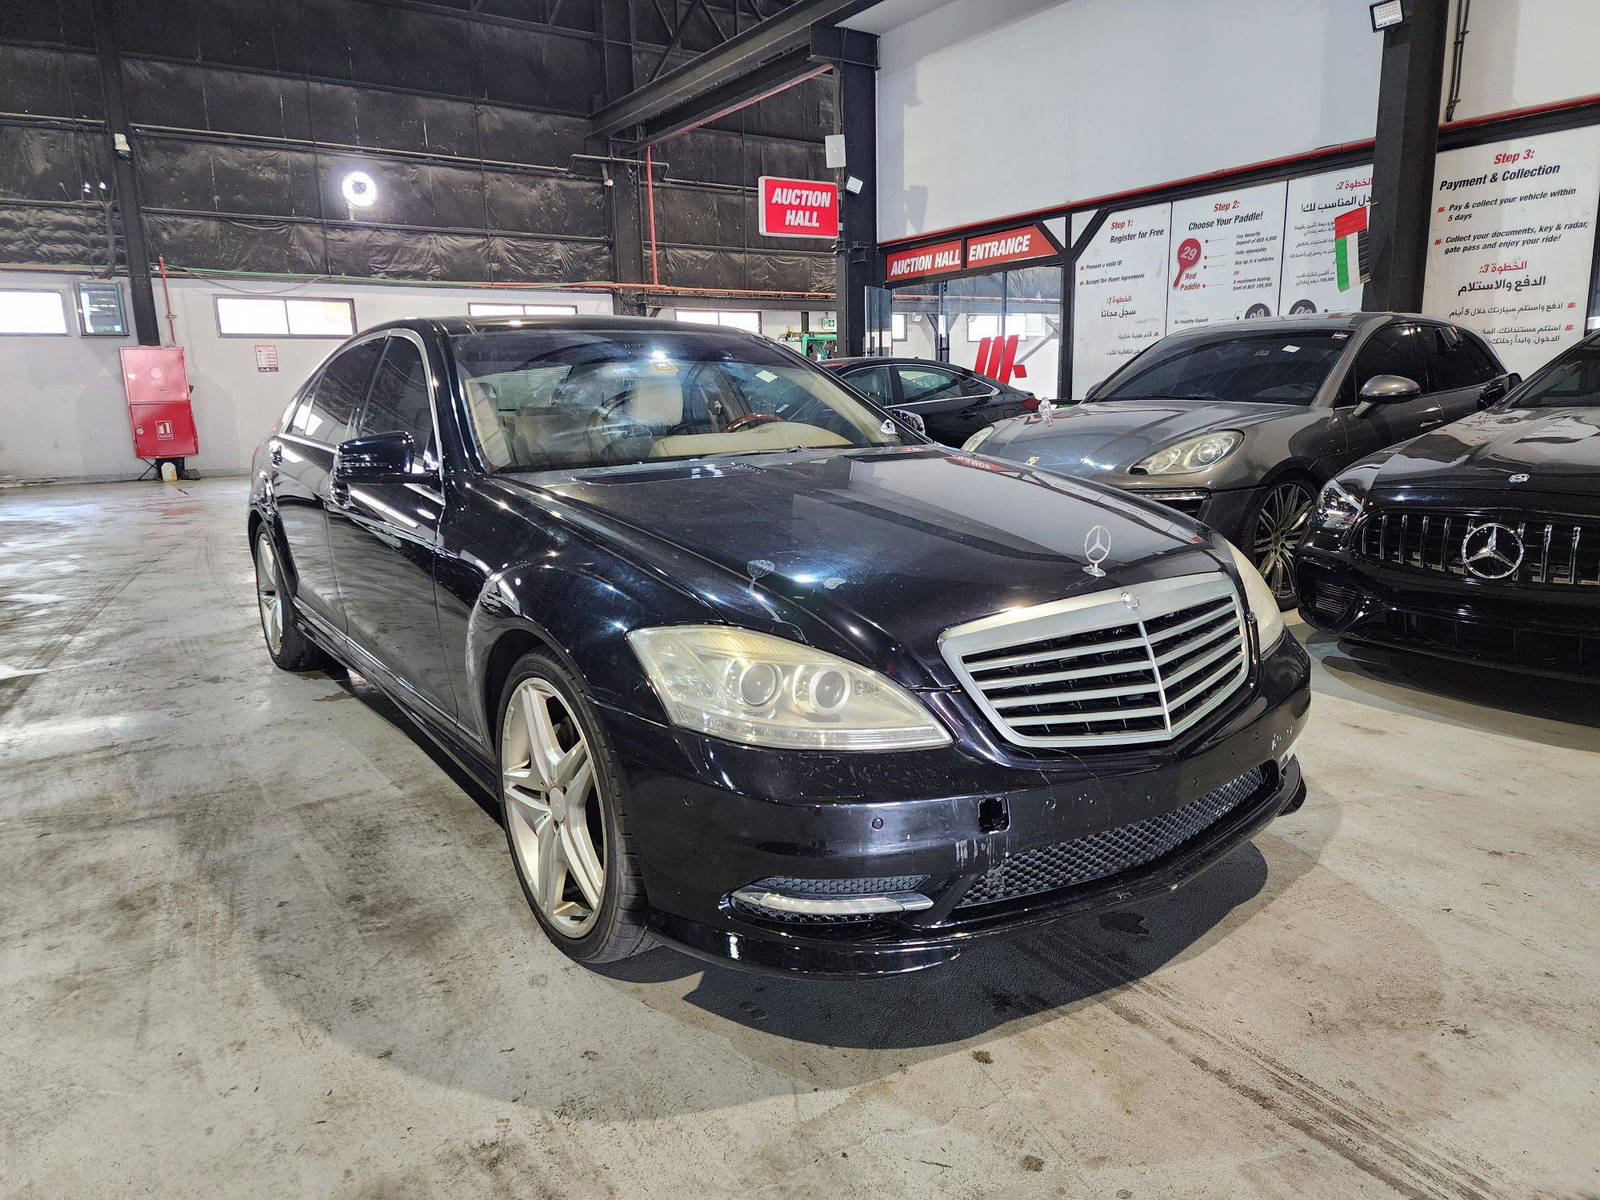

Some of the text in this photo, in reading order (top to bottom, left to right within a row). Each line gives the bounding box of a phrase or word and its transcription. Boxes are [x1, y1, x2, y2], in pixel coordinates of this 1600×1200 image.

[1494, 149, 1535, 165] Step 3:
[1440, 164, 1560, 191] Payment & Collection
[772, 187, 831, 208] AUCTION
[1213, 200, 1240, 212] Step 2:
[1449, 204, 1463, 213] Pay
[1472, 199, 1498, 208] collect
[1499, 197, 1517, 206] your
[1519, 191, 1548, 202] vehicle
[1550, 188, 1577, 198] within
[785, 209, 820, 228] HALL
[1110, 221, 1126, 230] Step
[1188, 211, 1264, 231] Choose Your Paddle!
[1447, 212, 1473, 222] 5 days
[1109, 228, 1165, 244] Register for Free
[1445, 221, 1588, 244] Collect your documents, key & radar,
[968, 234, 1032, 262] ENTRANCE
[1181, 246, 1198, 260] 29
[1444, 234, 1562, 255] gate pass and enjoy your ride!
[890, 249, 962, 276] AUCTION HALL
[1479, 260, 1527, 275] الخطوة 3:
[1185, 272, 1197, 280] Red
[1180, 283, 1200, 291] Paddle
[1457, 275, 1547, 296] الدفع والاستلام
[1488, 307, 1516, 316] سيارتك
